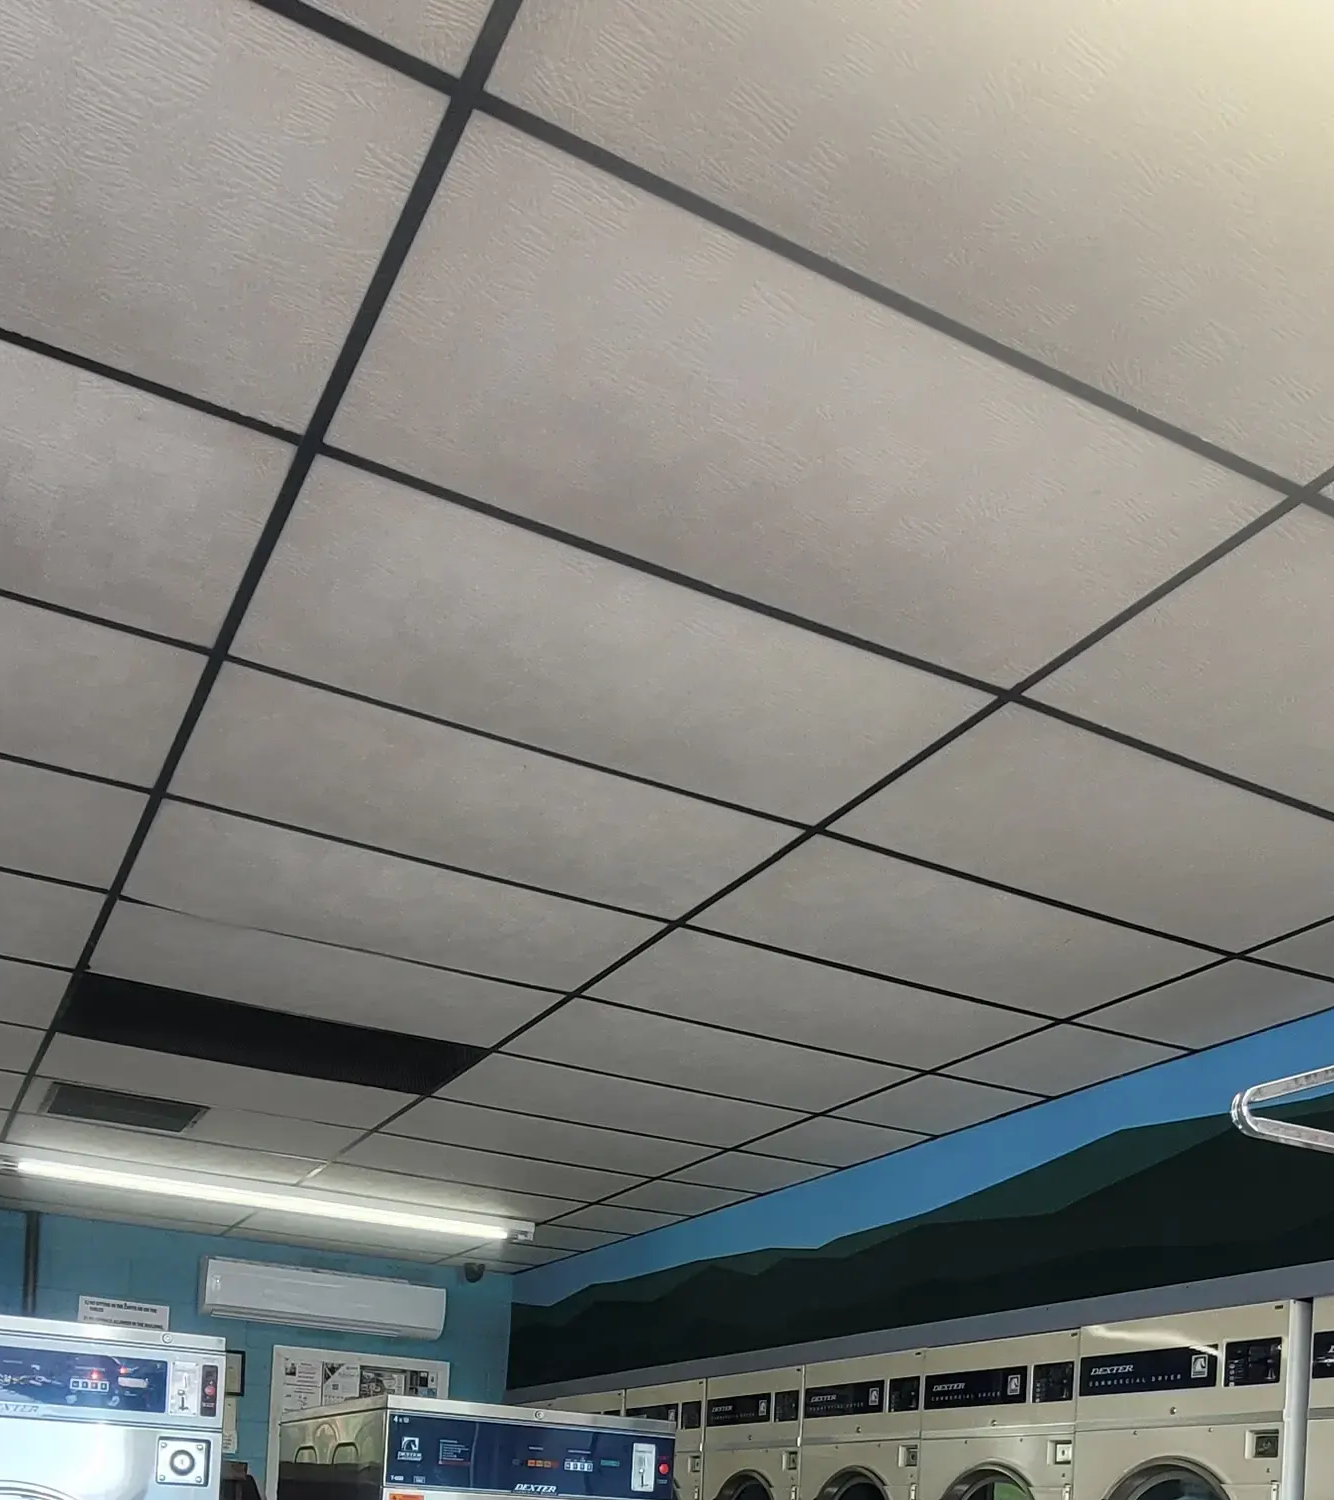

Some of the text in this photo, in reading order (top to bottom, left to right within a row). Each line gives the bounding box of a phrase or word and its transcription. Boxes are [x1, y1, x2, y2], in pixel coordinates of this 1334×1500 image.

[1090, 1364, 1134, 1376] DEXTER
[932, 1383, 965, 1392] DEXTER
[1089, 1377, 1146, 1388] COMMERCIAL
[515, 1483, 557, 1493] DEXTER
